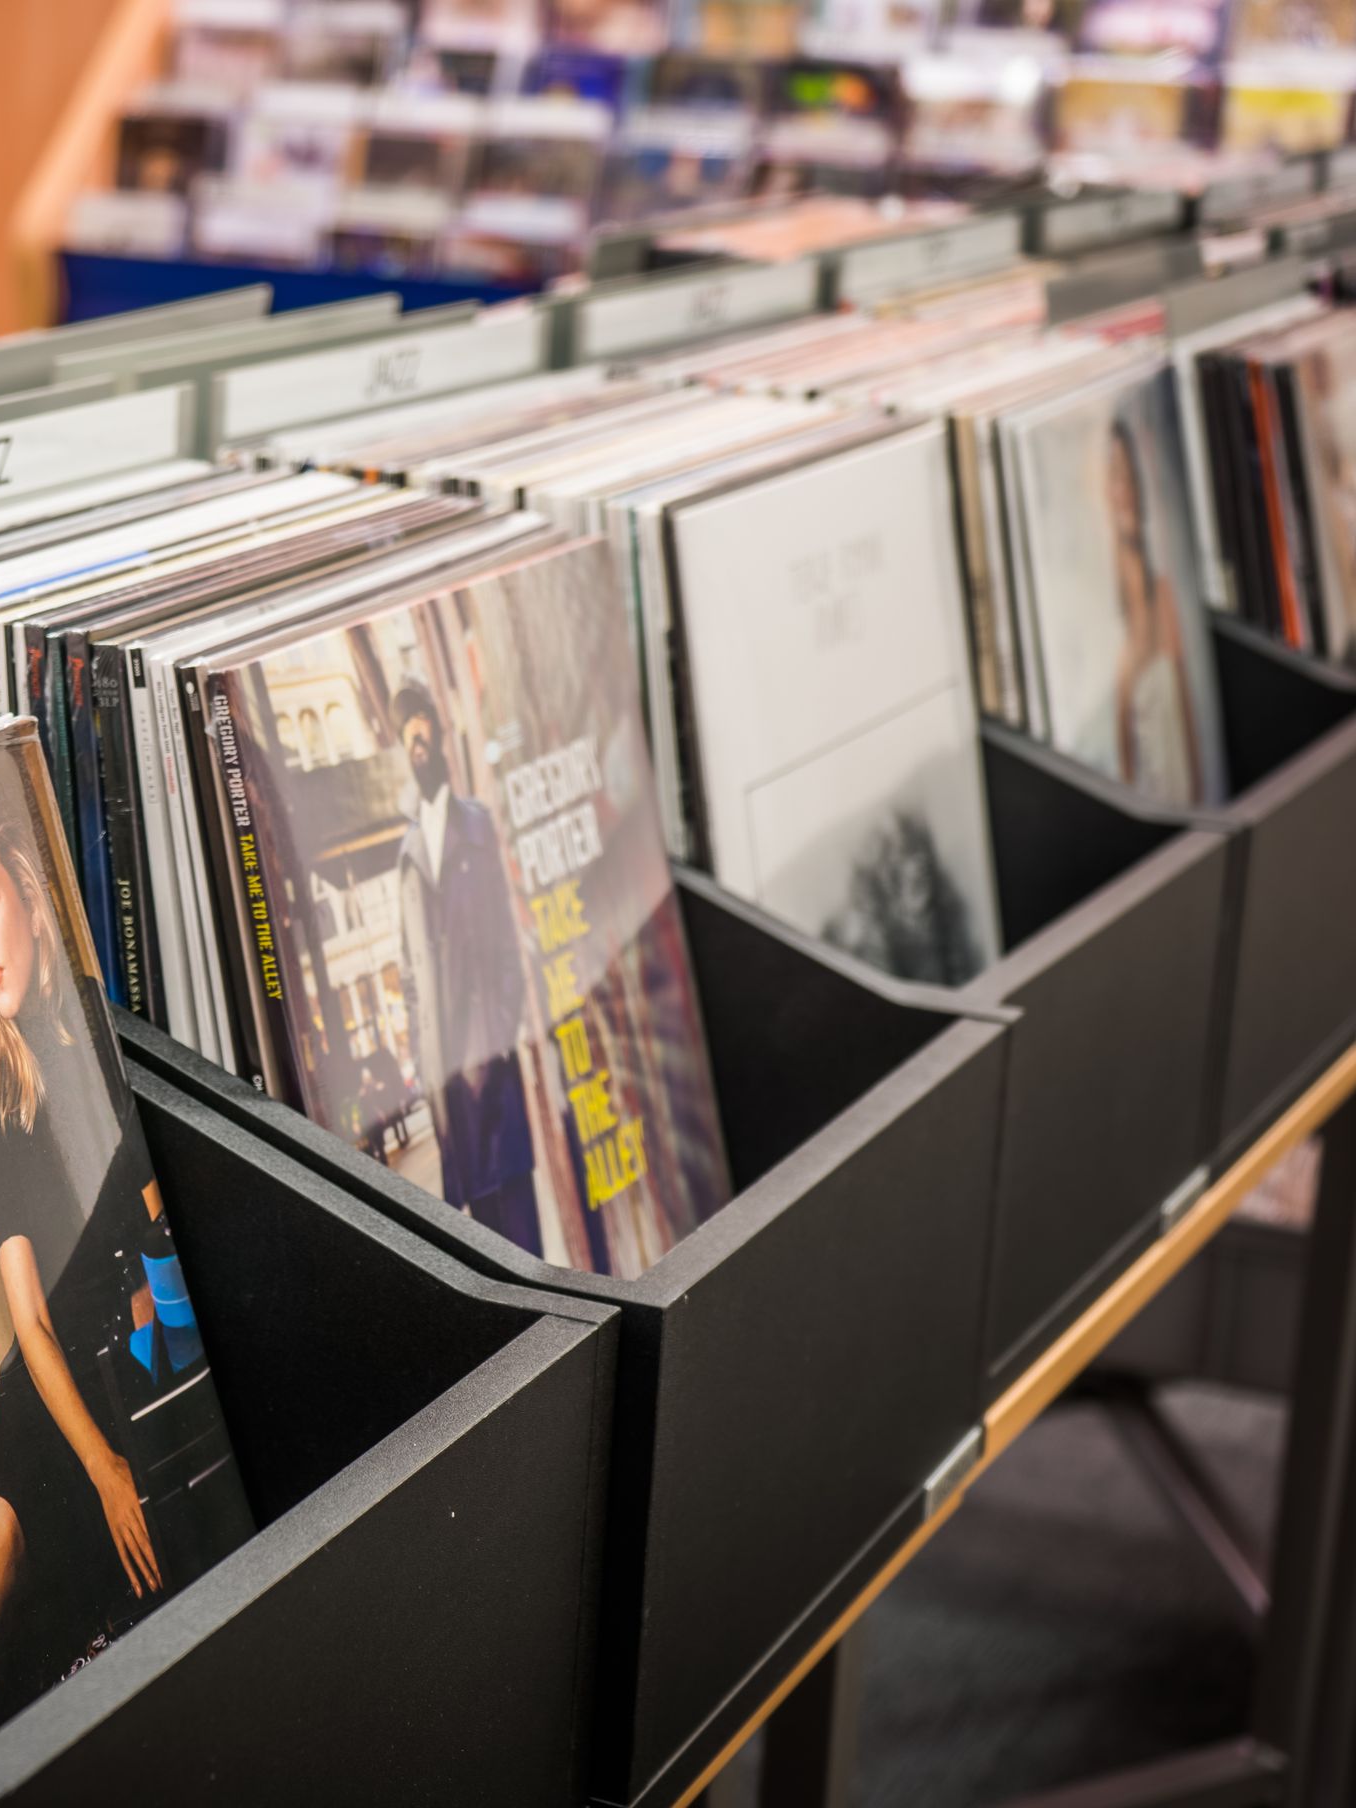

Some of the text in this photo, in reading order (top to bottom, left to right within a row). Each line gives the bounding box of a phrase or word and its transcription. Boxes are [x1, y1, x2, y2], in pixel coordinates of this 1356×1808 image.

[505, 735, 603, 829] GREGORY
[213, 694, 284, 1001] GREGORY PORTER TAKE ME TO THE ALLEY
[517, 801, 604, 895] PORTER
[117, 878, 142, 1013] JOE BONAMASSA
[531, 879, 591, 954] TAKE
[542, 951, 586, 1022] ME
[555, 1016, 593, 1083] TO
[568, 1068, 619, 1146] THE
[583, 1116, 649, 1213] ALLEY
